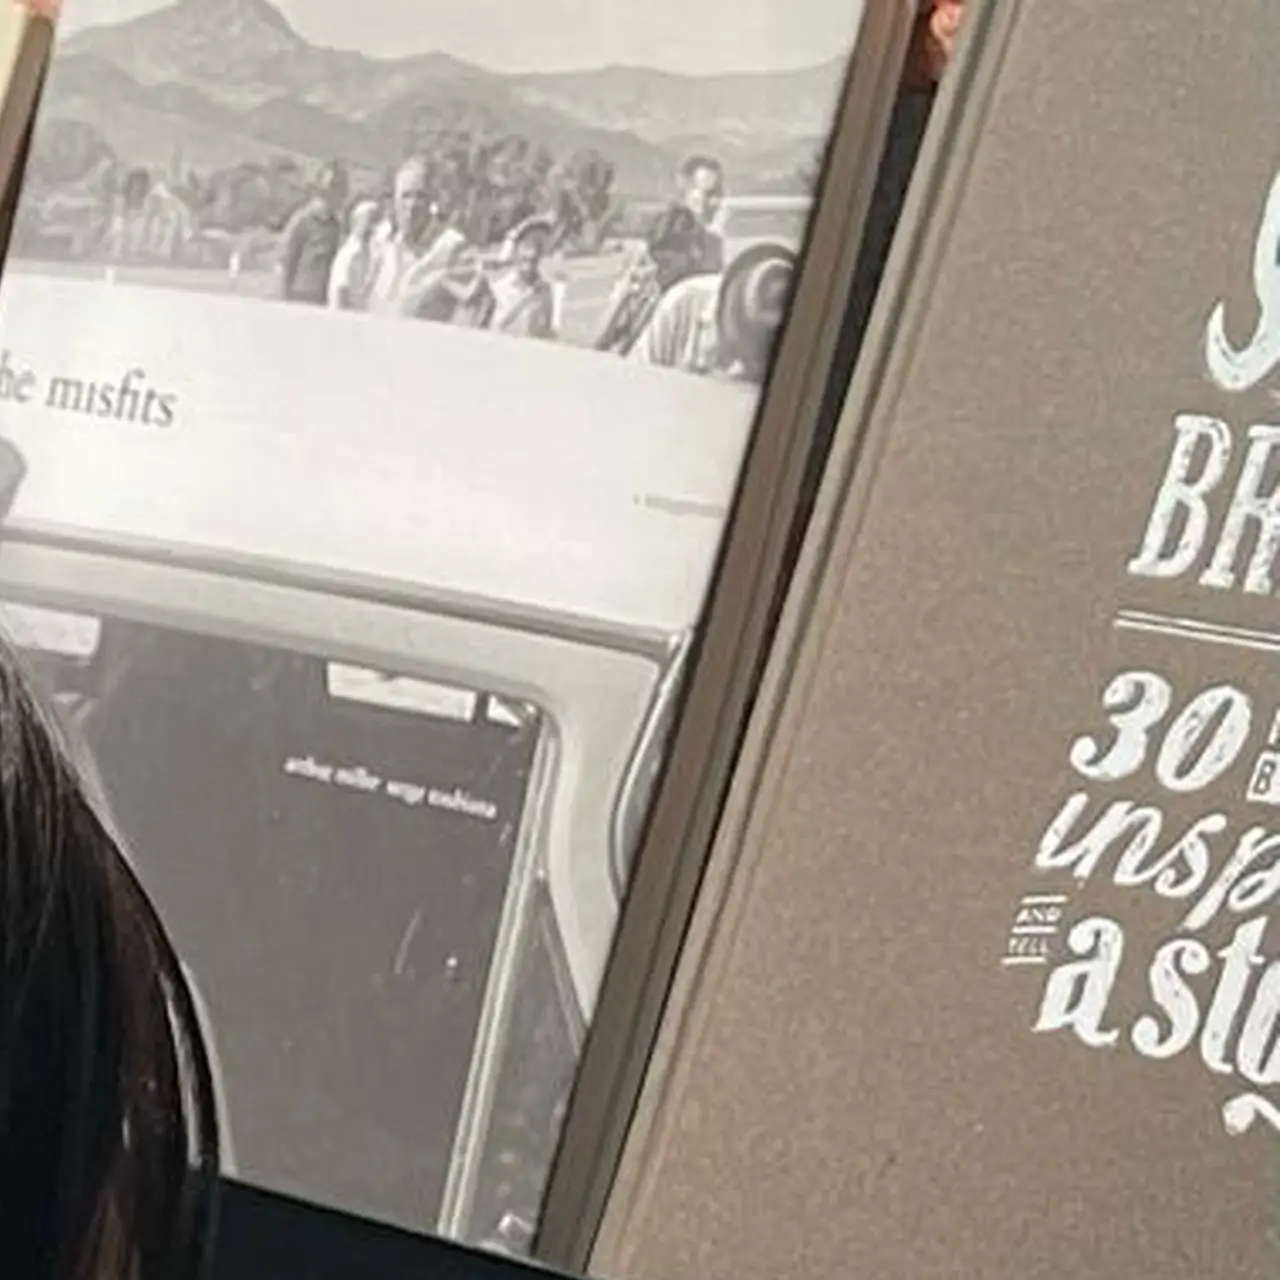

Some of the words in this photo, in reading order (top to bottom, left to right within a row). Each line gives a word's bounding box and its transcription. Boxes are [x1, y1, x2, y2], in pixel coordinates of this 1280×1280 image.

[45, 367, 178, 429] misfits
[1070, 670, 1252, 792] 30
[1032, 916, 1122, 1047] a
